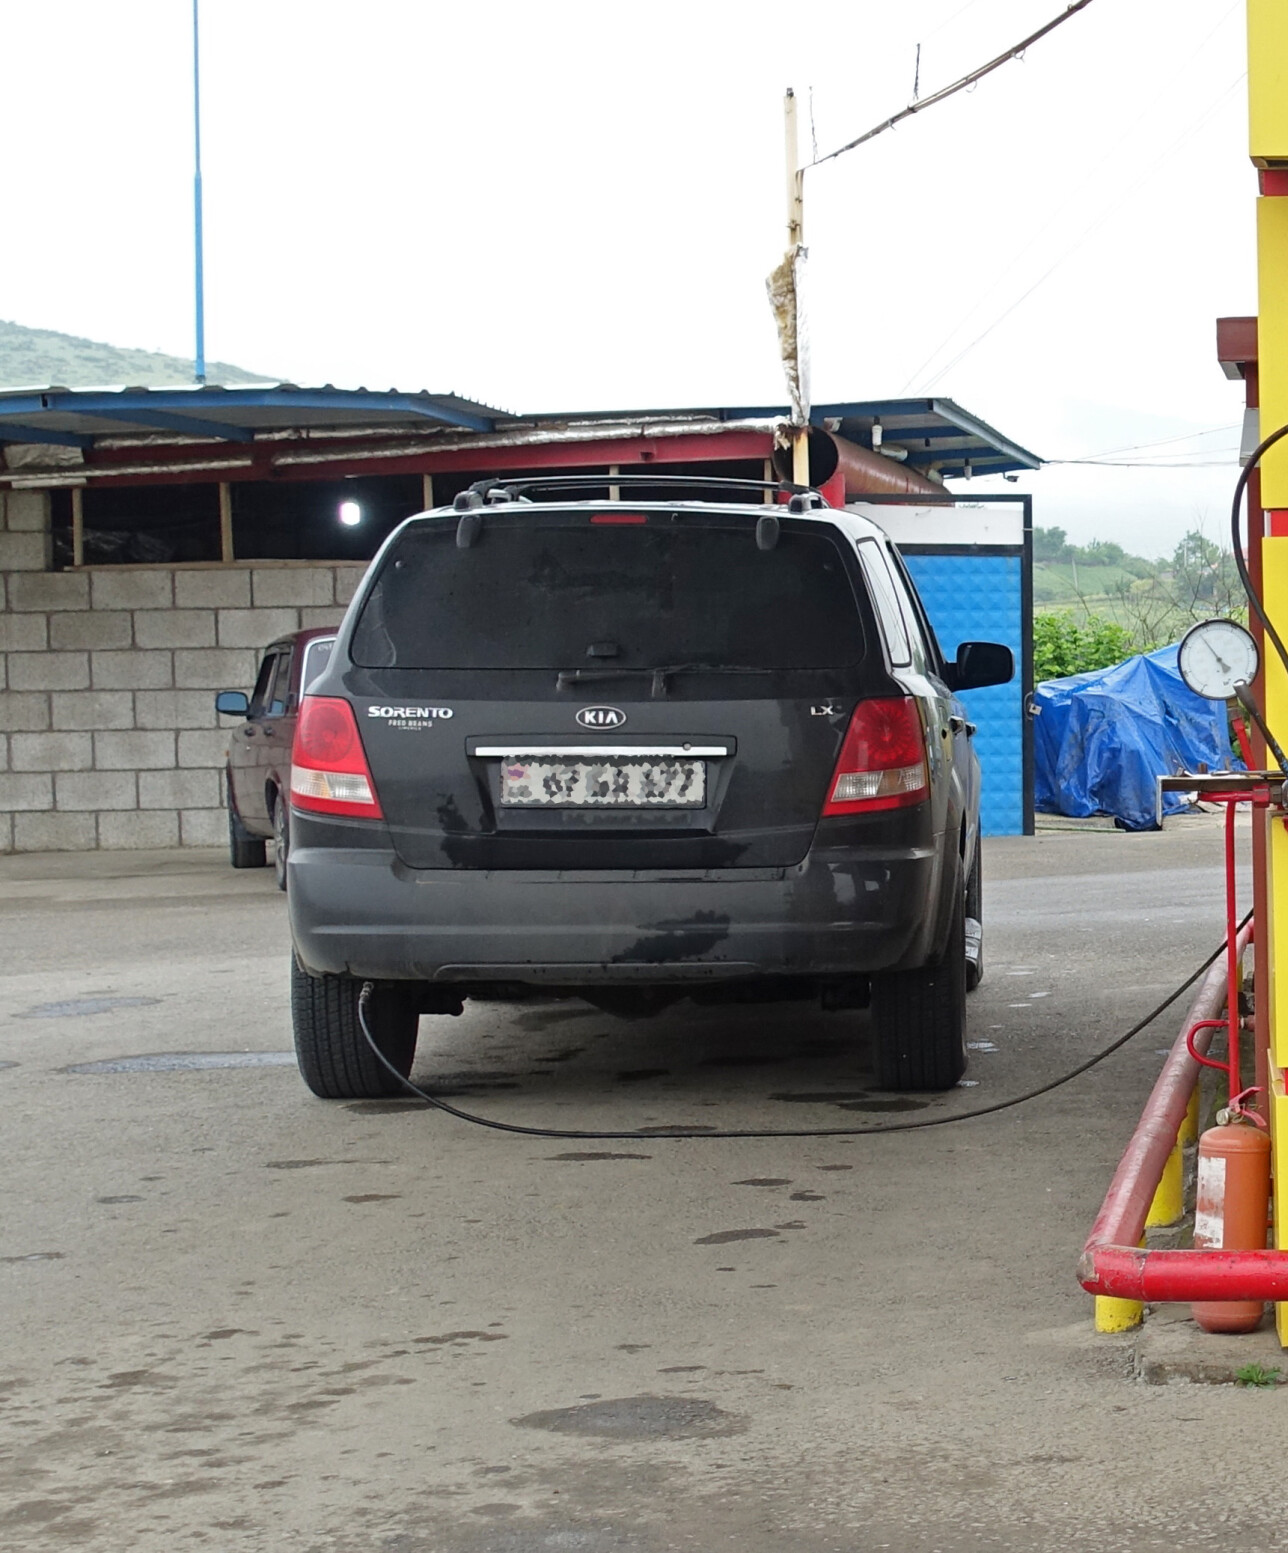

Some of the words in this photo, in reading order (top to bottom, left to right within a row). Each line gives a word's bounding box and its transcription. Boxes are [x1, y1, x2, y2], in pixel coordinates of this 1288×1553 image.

[368, 706, 454, 719] SORENTO
[584, 710, 619, 724] KIA
[810, 705, 834, 716] LX
